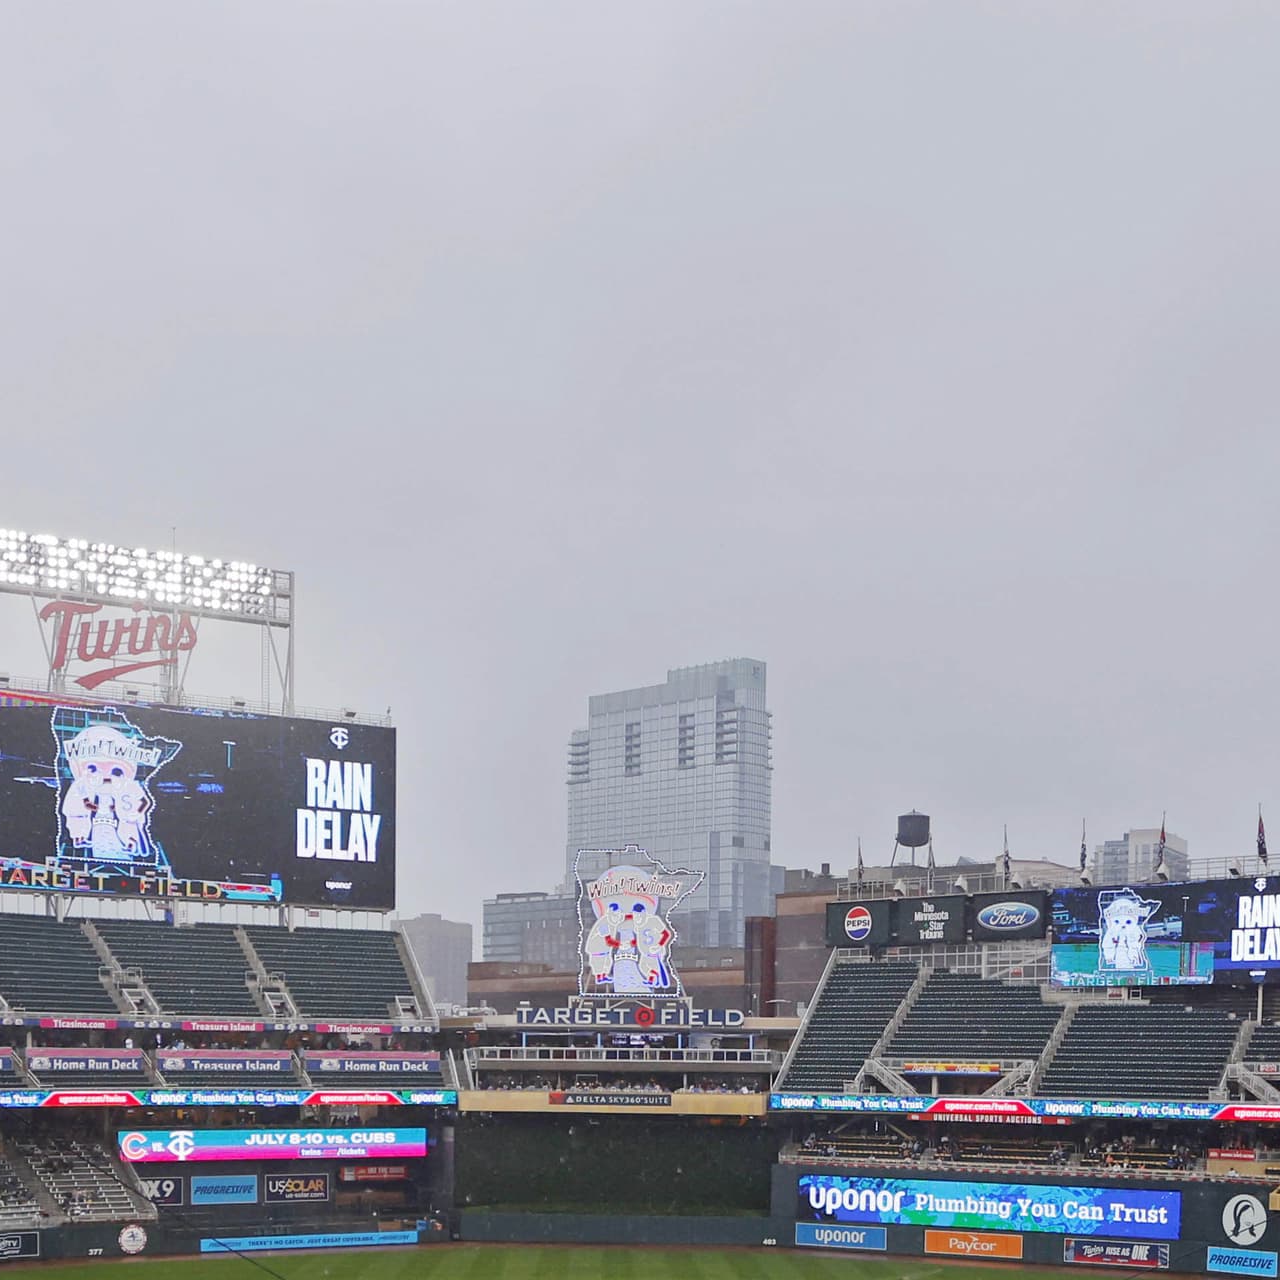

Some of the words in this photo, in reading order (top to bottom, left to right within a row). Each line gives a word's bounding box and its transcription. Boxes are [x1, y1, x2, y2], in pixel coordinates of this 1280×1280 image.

[40, 600, 198, 690] Twins
[306, 757, 373, 812] RAIN
[296, 807, 382, 863] DELAY
[139, 876, 223, 899] FIELD
[325, 880, 353, 890] uponor
[587, 877, 625, 899] Win!
[627, 875, 680, 899] Twins!
[923, 902, 935, 912] The
[914, 910, 949, 922] Minnesota
[989, 906, 1027, 927] Ford
[846, 919, 870, 928] PEPSI
[928, 920, 945, 932] Star
[919, 929, 944, 939] Tribune
[517, 1007, 631, 1026] TARGET
[661, 1008, 745, 1027] FIELD
[190, 1021, 231, 1032] Treasure
[233, 1022, 256, 1032] Island
[53, 1058, 84, 1070] Home
[87, 1058, 110, 1070] Run
[112, 1058, 139, 1071] Deck
[191, 1059, 243, 1071] Treasure
[246, 1060, 281, 1072] Island
[344, 1060, 374, 1072] Home
[378, 1061, 399, 1072] Run
[402, 1061, 429, 1073] Deck
[12, 1094, 38, 1105] Trust
[150, 1094, 187, 1105] uponor
[191, 1092, 236, 1105] Plumbing
[237, 1093, 255, 1104] You
[410, 1093, 444, 1105] uponor
[576, 1095, 605, 1104] DELTA
[645, 1095, 669, 1105] SUITE
[780, 1097, 816, 1108] uponor
[821, 1098, 862, 1109] Plumbing
[863, 1099, 880, 1109] You
[881, 1099, 898, 1109] Can
[900, 1099, 924, 1109] Trust
[1045, 1102, 1084, 1114] uponor
[1092, 1104, 1138, 1116] Plumbing
[1140, 1105, 1160, 1116] You
[1161, 1105, 1181, 1116] Can
[1182, 1106, 1210, 1117] Trust
[933, 1113, 973, 1122] UNIVERSAL
[975, 1115, 1003, 1124] SPORTS
[1006, 1115, 1042, 1125] AUCTIONS
[244, 1133, 286, 1146] JULY
[289, 1132, 323, 1145] 8-10
[325, 1134, 349, 1145] vs.
[350, 1131, 397, 1145] CUBS
[162, 1180, 175, 1197] 9
[194, 1183, 255, 1196] PROGRESSIVE
[808, 1186, 906, 1215] uponor
[915, 1193, 1012, 1219] Plumbing
[1017, 1199, 1057, 1219] You
[1062, 1203, 1105, 1222] Can
[1109, 1203, 1168, 1224] Trust
[815, 1228, 866, 1244] uponor
[949, 1237, 997, 1254] Paycor
[1082, 1244, 1105, 1257] Twins
[1105, 1246, 1121, 1256] RISE
[1131, 1244, 1151, 1261] ONE
[1209, 1253, 1274, 1270] PROGRESSIVE
